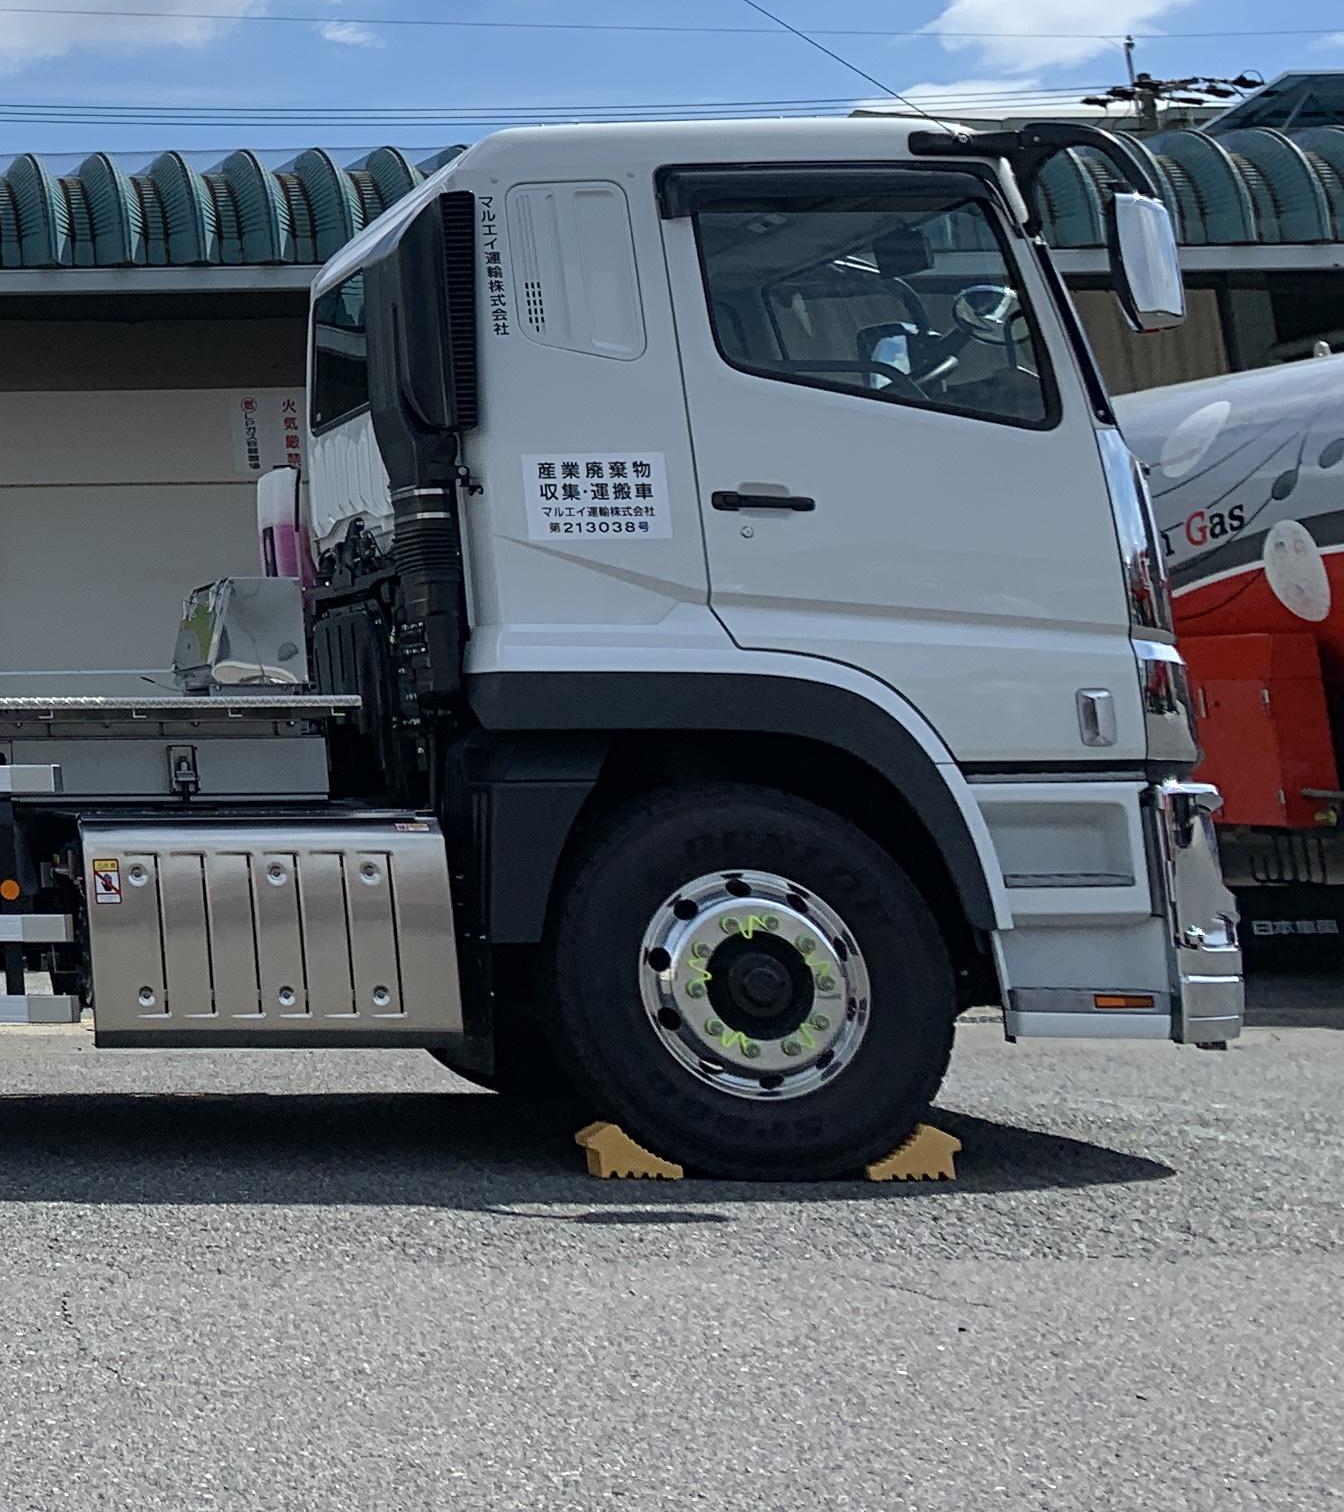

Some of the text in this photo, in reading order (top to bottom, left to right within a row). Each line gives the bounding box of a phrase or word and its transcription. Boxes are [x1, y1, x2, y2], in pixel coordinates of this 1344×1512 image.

[479, 196, 510, 336] マルエイ運輸株式会社
[537, 461, 651, 479] 産業廃棄物
[542, 506, 656, 517] マルエイ運輸株式会社
[549, 521, 649, 533] 第213038号
[1185, 504, 1245, 546] Gas
